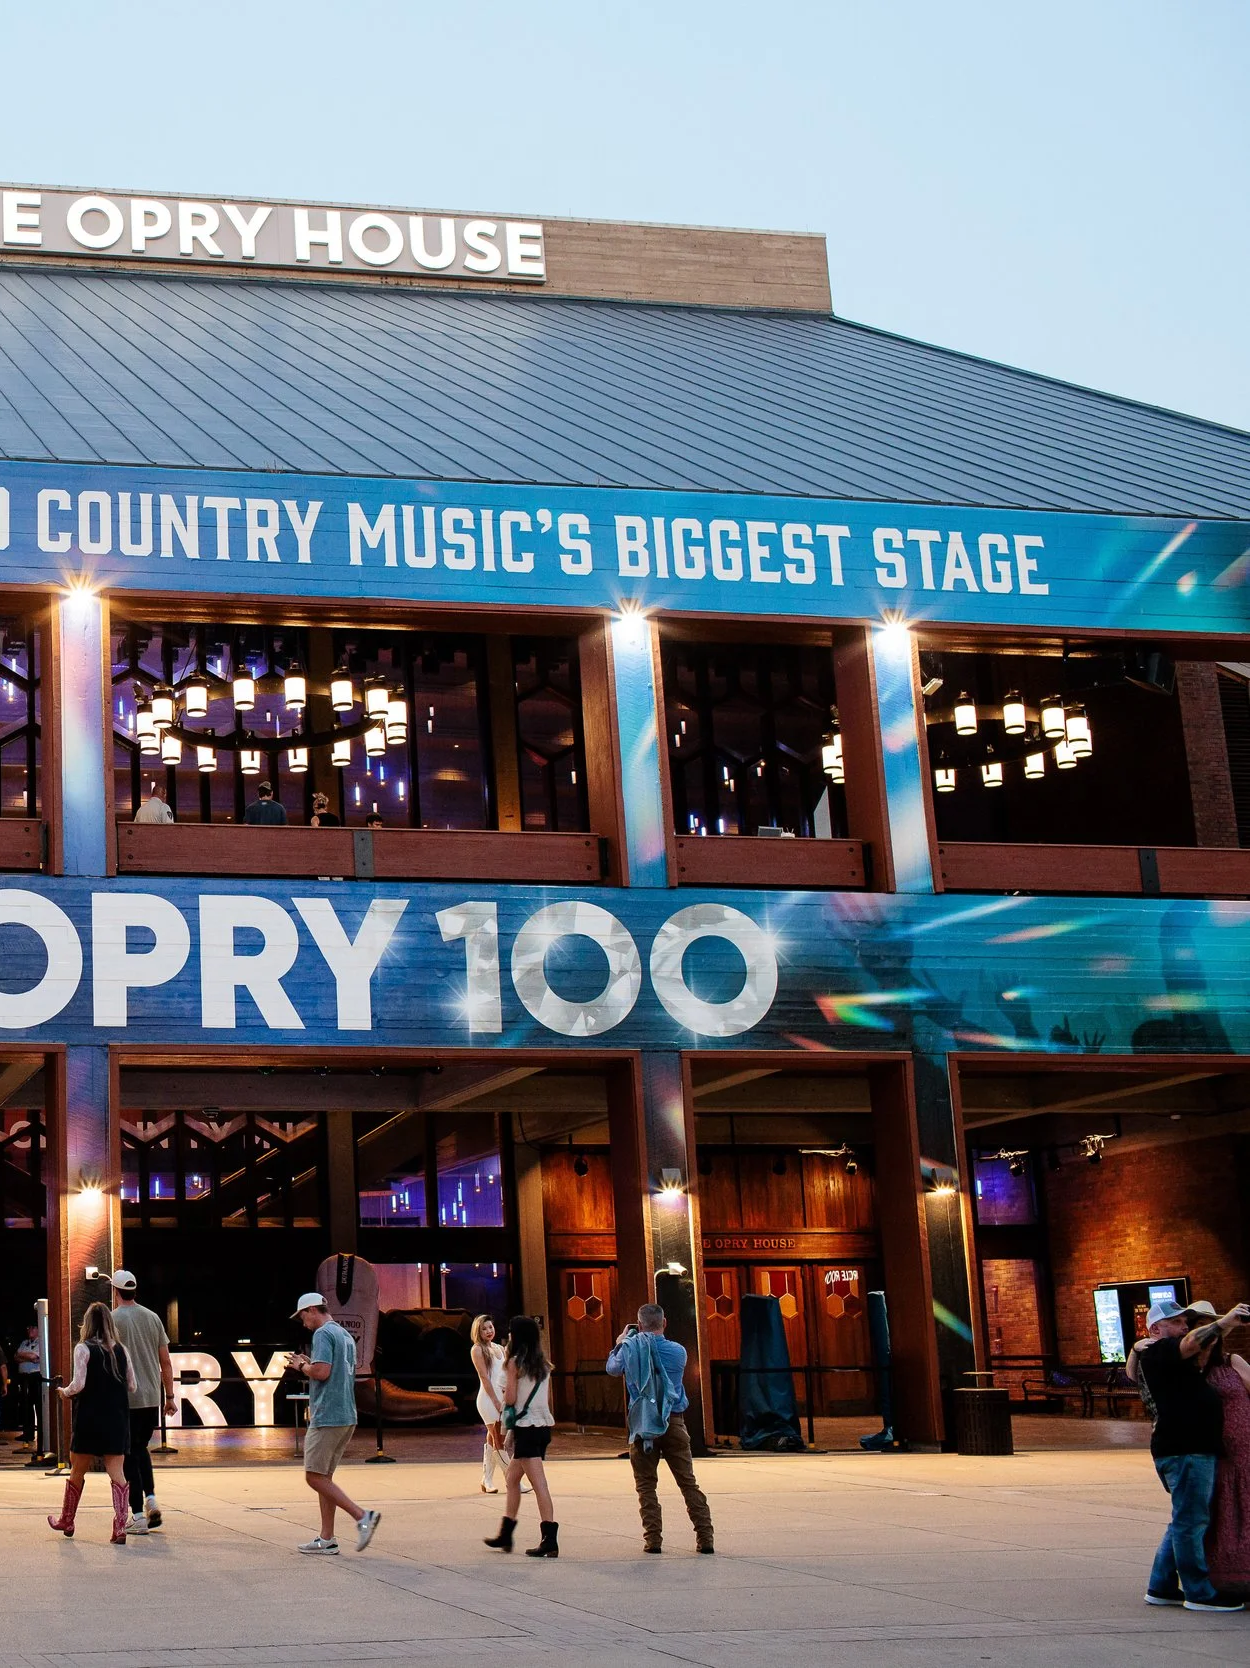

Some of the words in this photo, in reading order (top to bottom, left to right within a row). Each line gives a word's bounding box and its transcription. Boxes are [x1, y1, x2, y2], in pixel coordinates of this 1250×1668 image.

[67, 196, 274, 259] OPRY
[294, 208, 544, 277] HOUSE
[37, 489, 320, 564] COUNTRY
[614, 515, 850, 587] BIGGEST
[873, 527, 1049, 595] STAGE
[436, 900, 779, 1037] 100
[715, 1239, 748, 1248] OPRY
[754, 1239, 795, 1248] HOUSE
